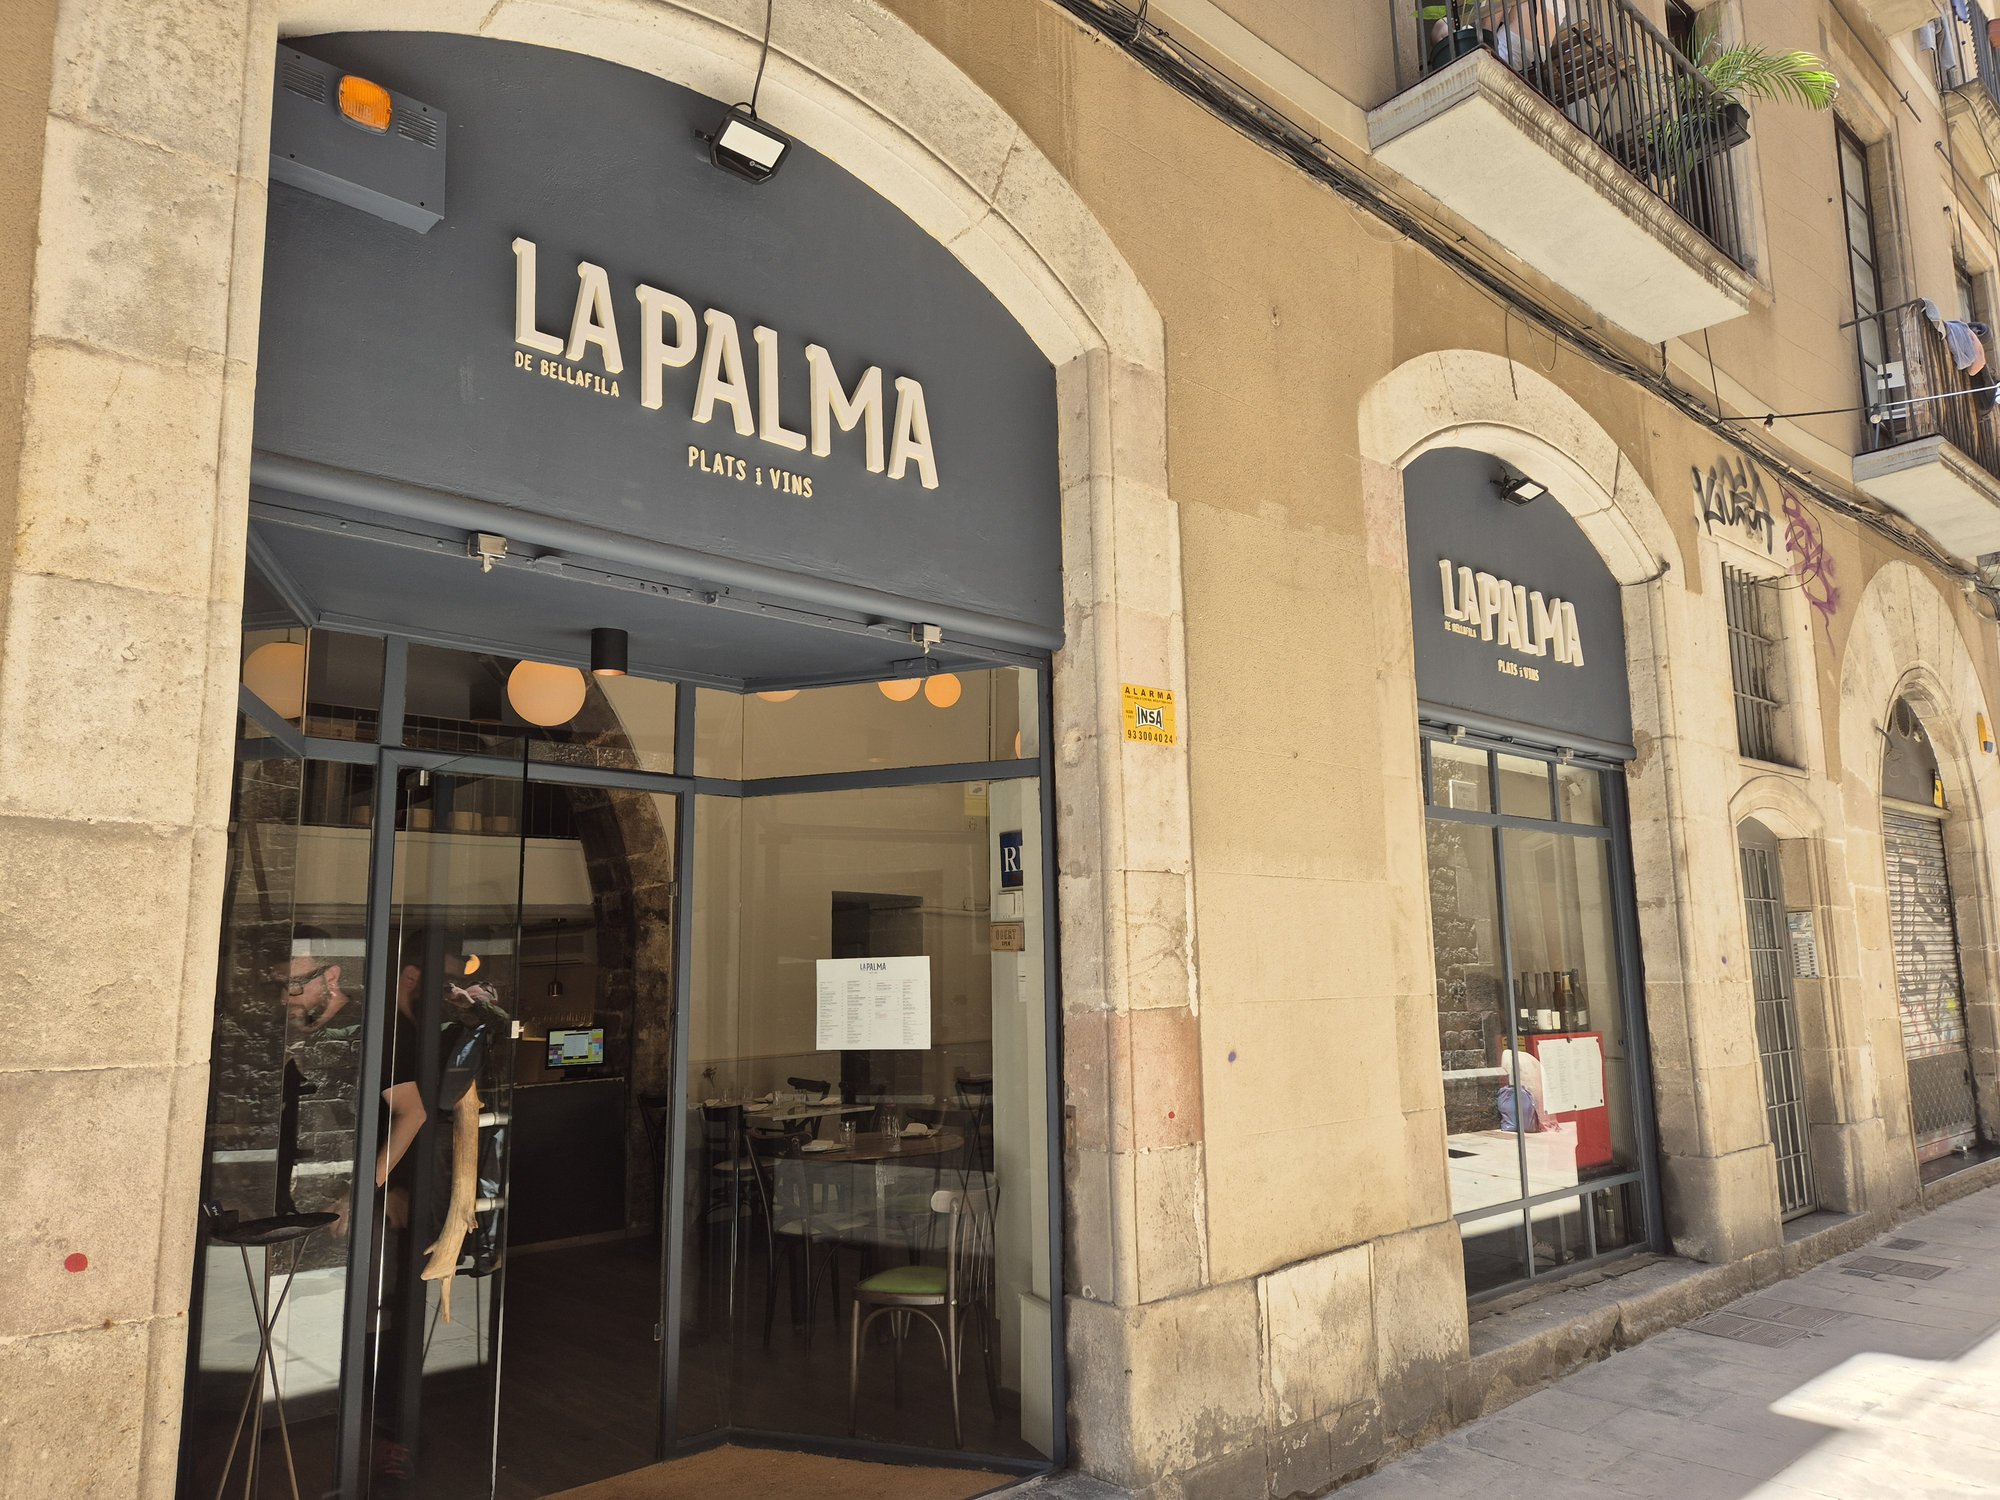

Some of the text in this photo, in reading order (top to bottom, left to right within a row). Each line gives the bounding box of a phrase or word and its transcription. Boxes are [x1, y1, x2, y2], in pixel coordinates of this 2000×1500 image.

[511, 236, 939, 490] LA PALMA
[514, 351, 620, 398] DE BELLAFILA
[688, 445, 747, 481] PLATS
[770, 468, 813, 498] VINS
[1438, 559, 1585, 667] LA PALMA
[1497, 659, 1518, 676] PLATS
[1523, 666, 1540, 682] VINS
[1125, 686, 1172, 700] ALARMA
[1137, 706, 1162, 728] INSA
[866, 962, 886, 971] PALMA
